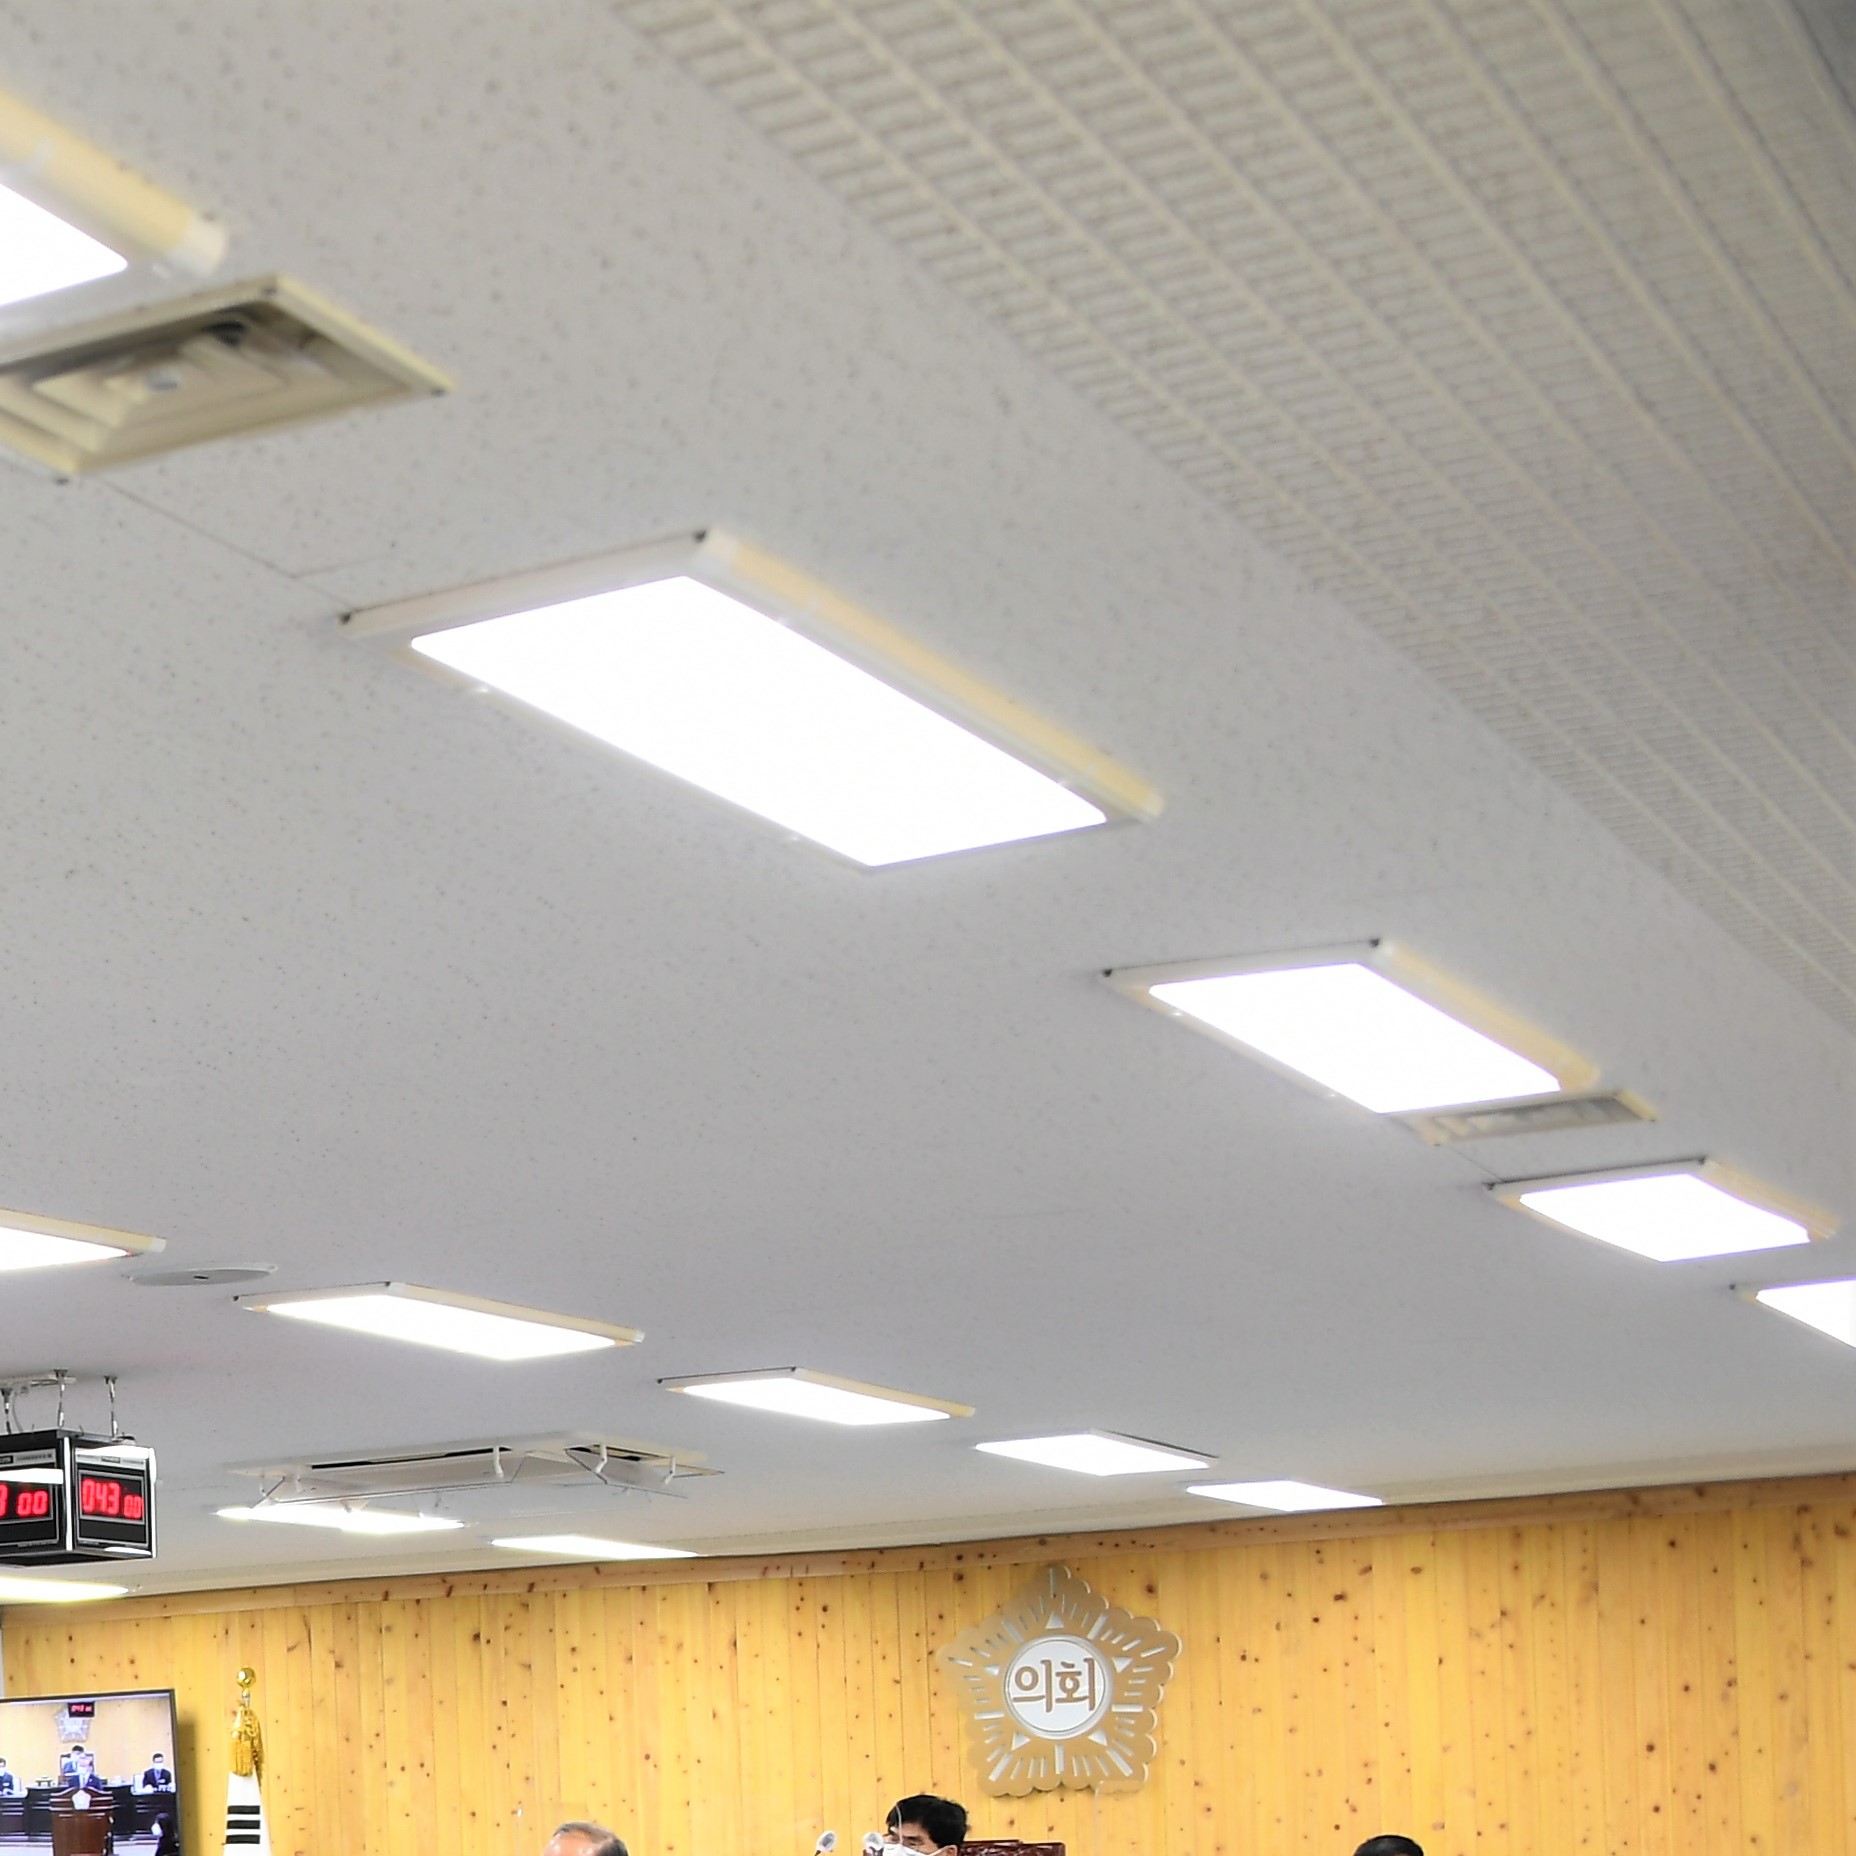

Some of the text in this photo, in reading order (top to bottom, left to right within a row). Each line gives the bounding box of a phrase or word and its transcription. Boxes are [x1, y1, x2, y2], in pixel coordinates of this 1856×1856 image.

[17, 1490, 48, 1517] 00
[81, 1478, 144, 1519] 043 00
[1012, 1657, 1097, 1713] 의회
